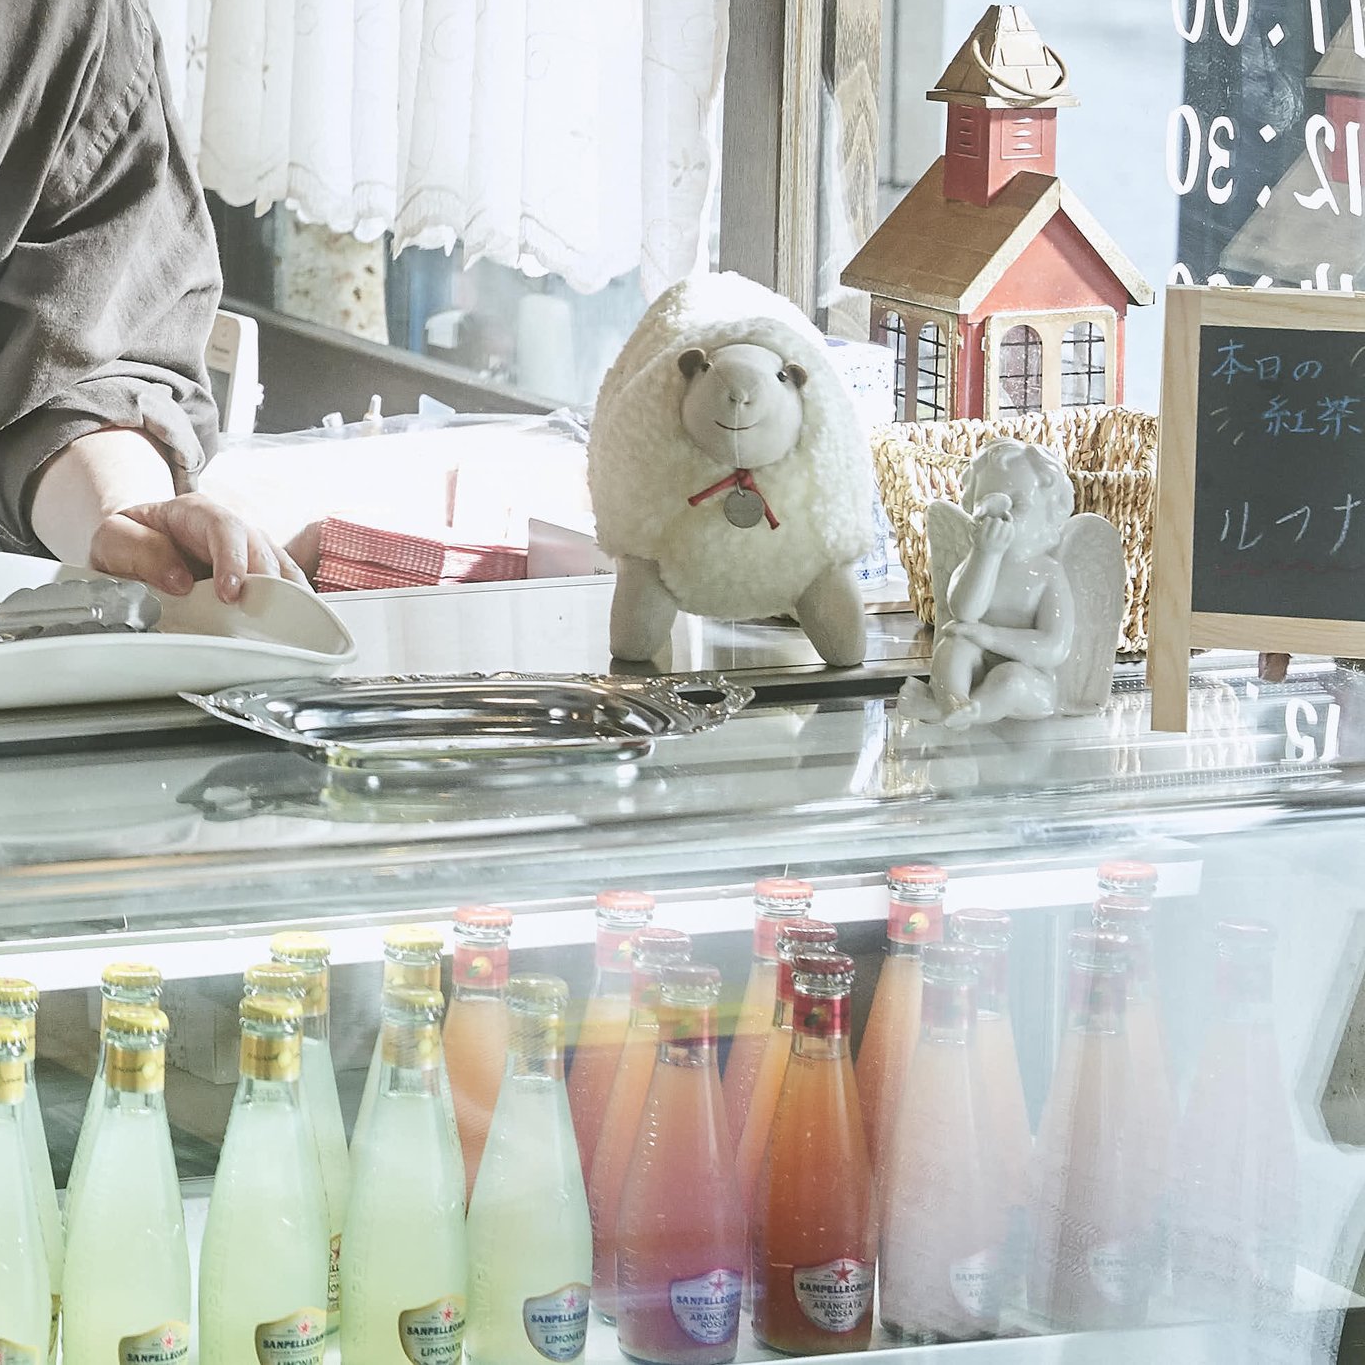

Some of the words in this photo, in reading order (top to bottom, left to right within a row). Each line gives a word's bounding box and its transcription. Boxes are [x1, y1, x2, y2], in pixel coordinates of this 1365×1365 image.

[1212, 339, 1323, 384] 本日の
[1262, 394, 1363, 441] 紅茶
